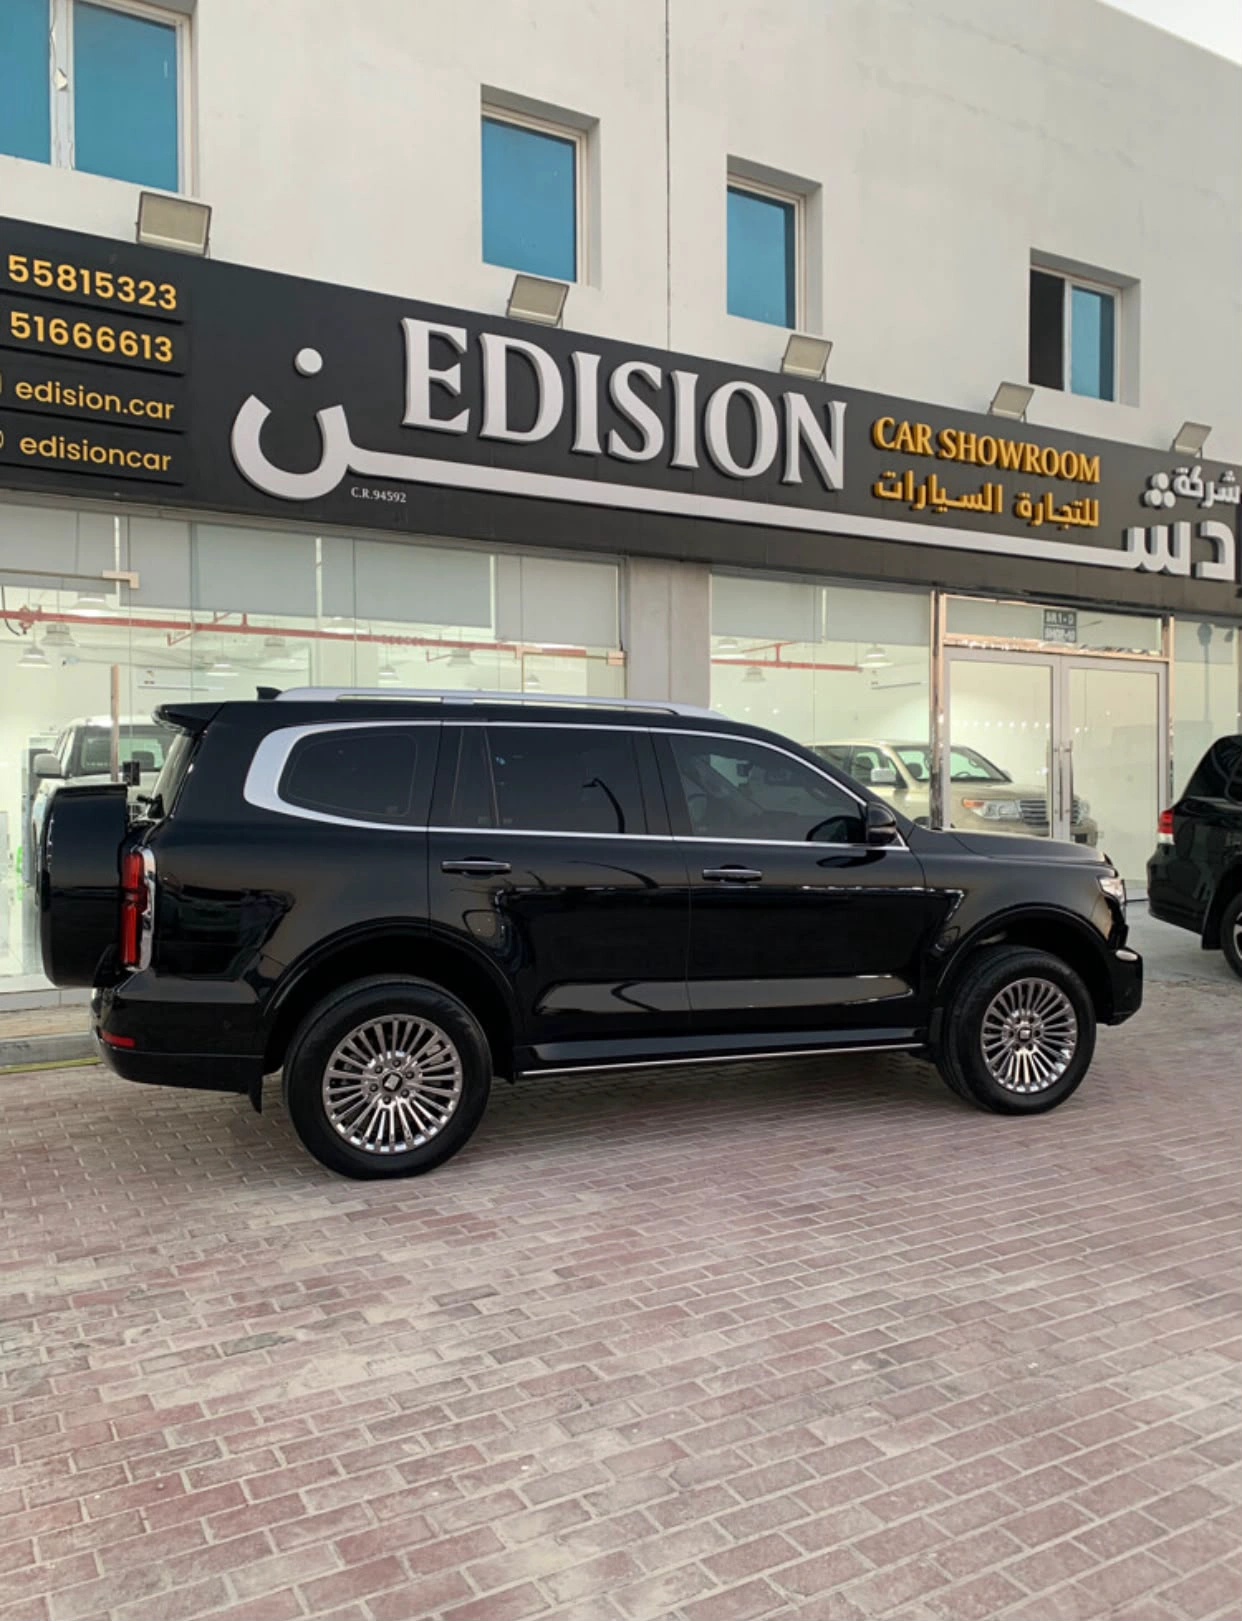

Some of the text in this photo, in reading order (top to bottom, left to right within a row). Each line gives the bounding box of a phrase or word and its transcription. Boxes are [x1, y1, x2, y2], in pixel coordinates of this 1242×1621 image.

[8, 254, 178, 310] 55815323
[10, 310, 174, 364] 51666613
[15, 380, 175, 421] edision.car
[401, 317, 848, 491] EDISION
[19, 433, 172, 473] edisioncar
[872, 416, 1101, 484] CAR SHOWROOM
[873, 469, 1099, 532] للتجارة السيارات
[1172, 464, 1241, 509] شركة
